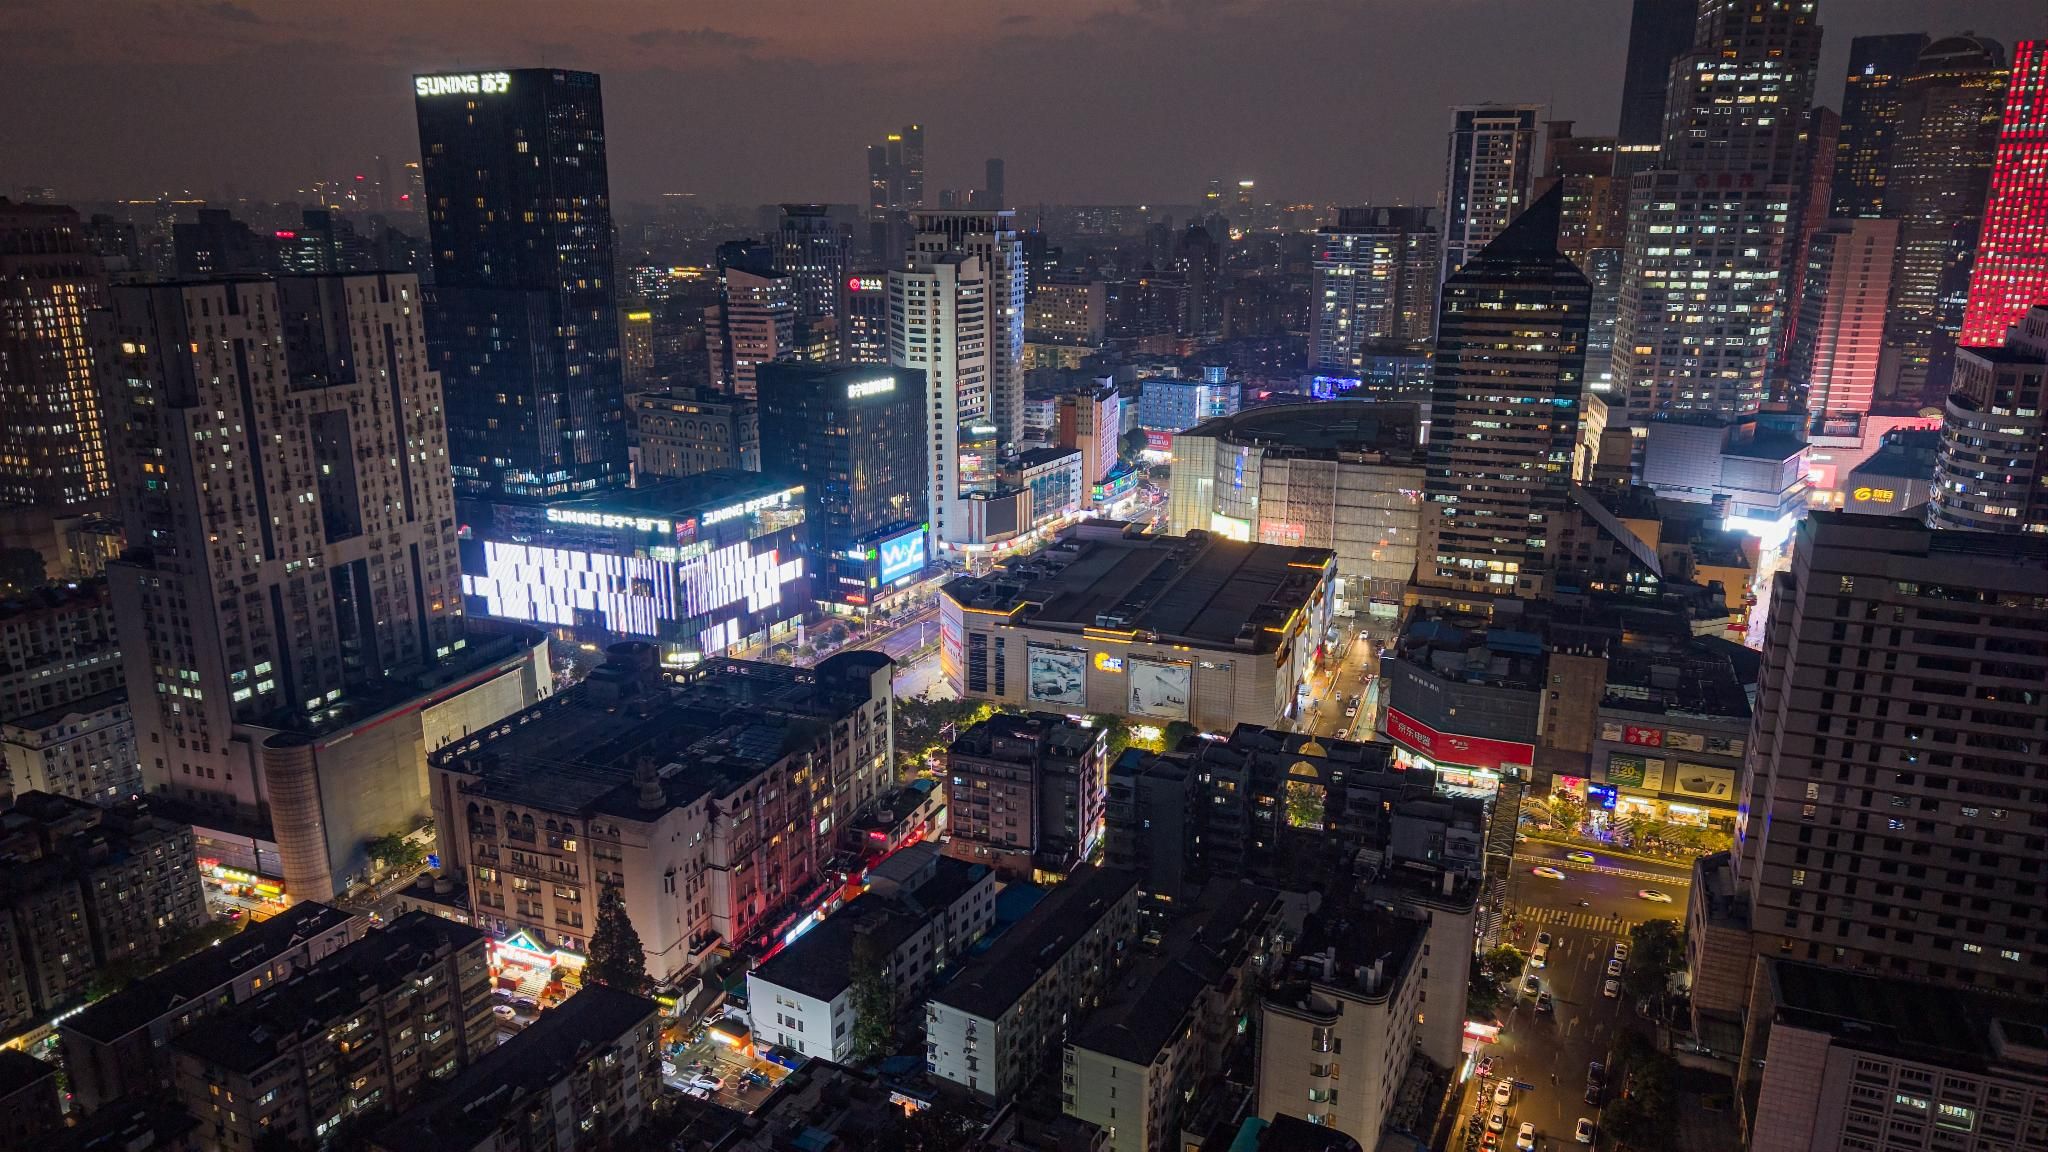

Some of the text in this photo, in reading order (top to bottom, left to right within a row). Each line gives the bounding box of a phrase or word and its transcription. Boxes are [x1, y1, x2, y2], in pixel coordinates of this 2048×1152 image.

[416, 72, 511, 96] SUNING 苏宁
[546, 508, 602, 527] SUNING
[1398, 722, 1432, 748] 京东电器
